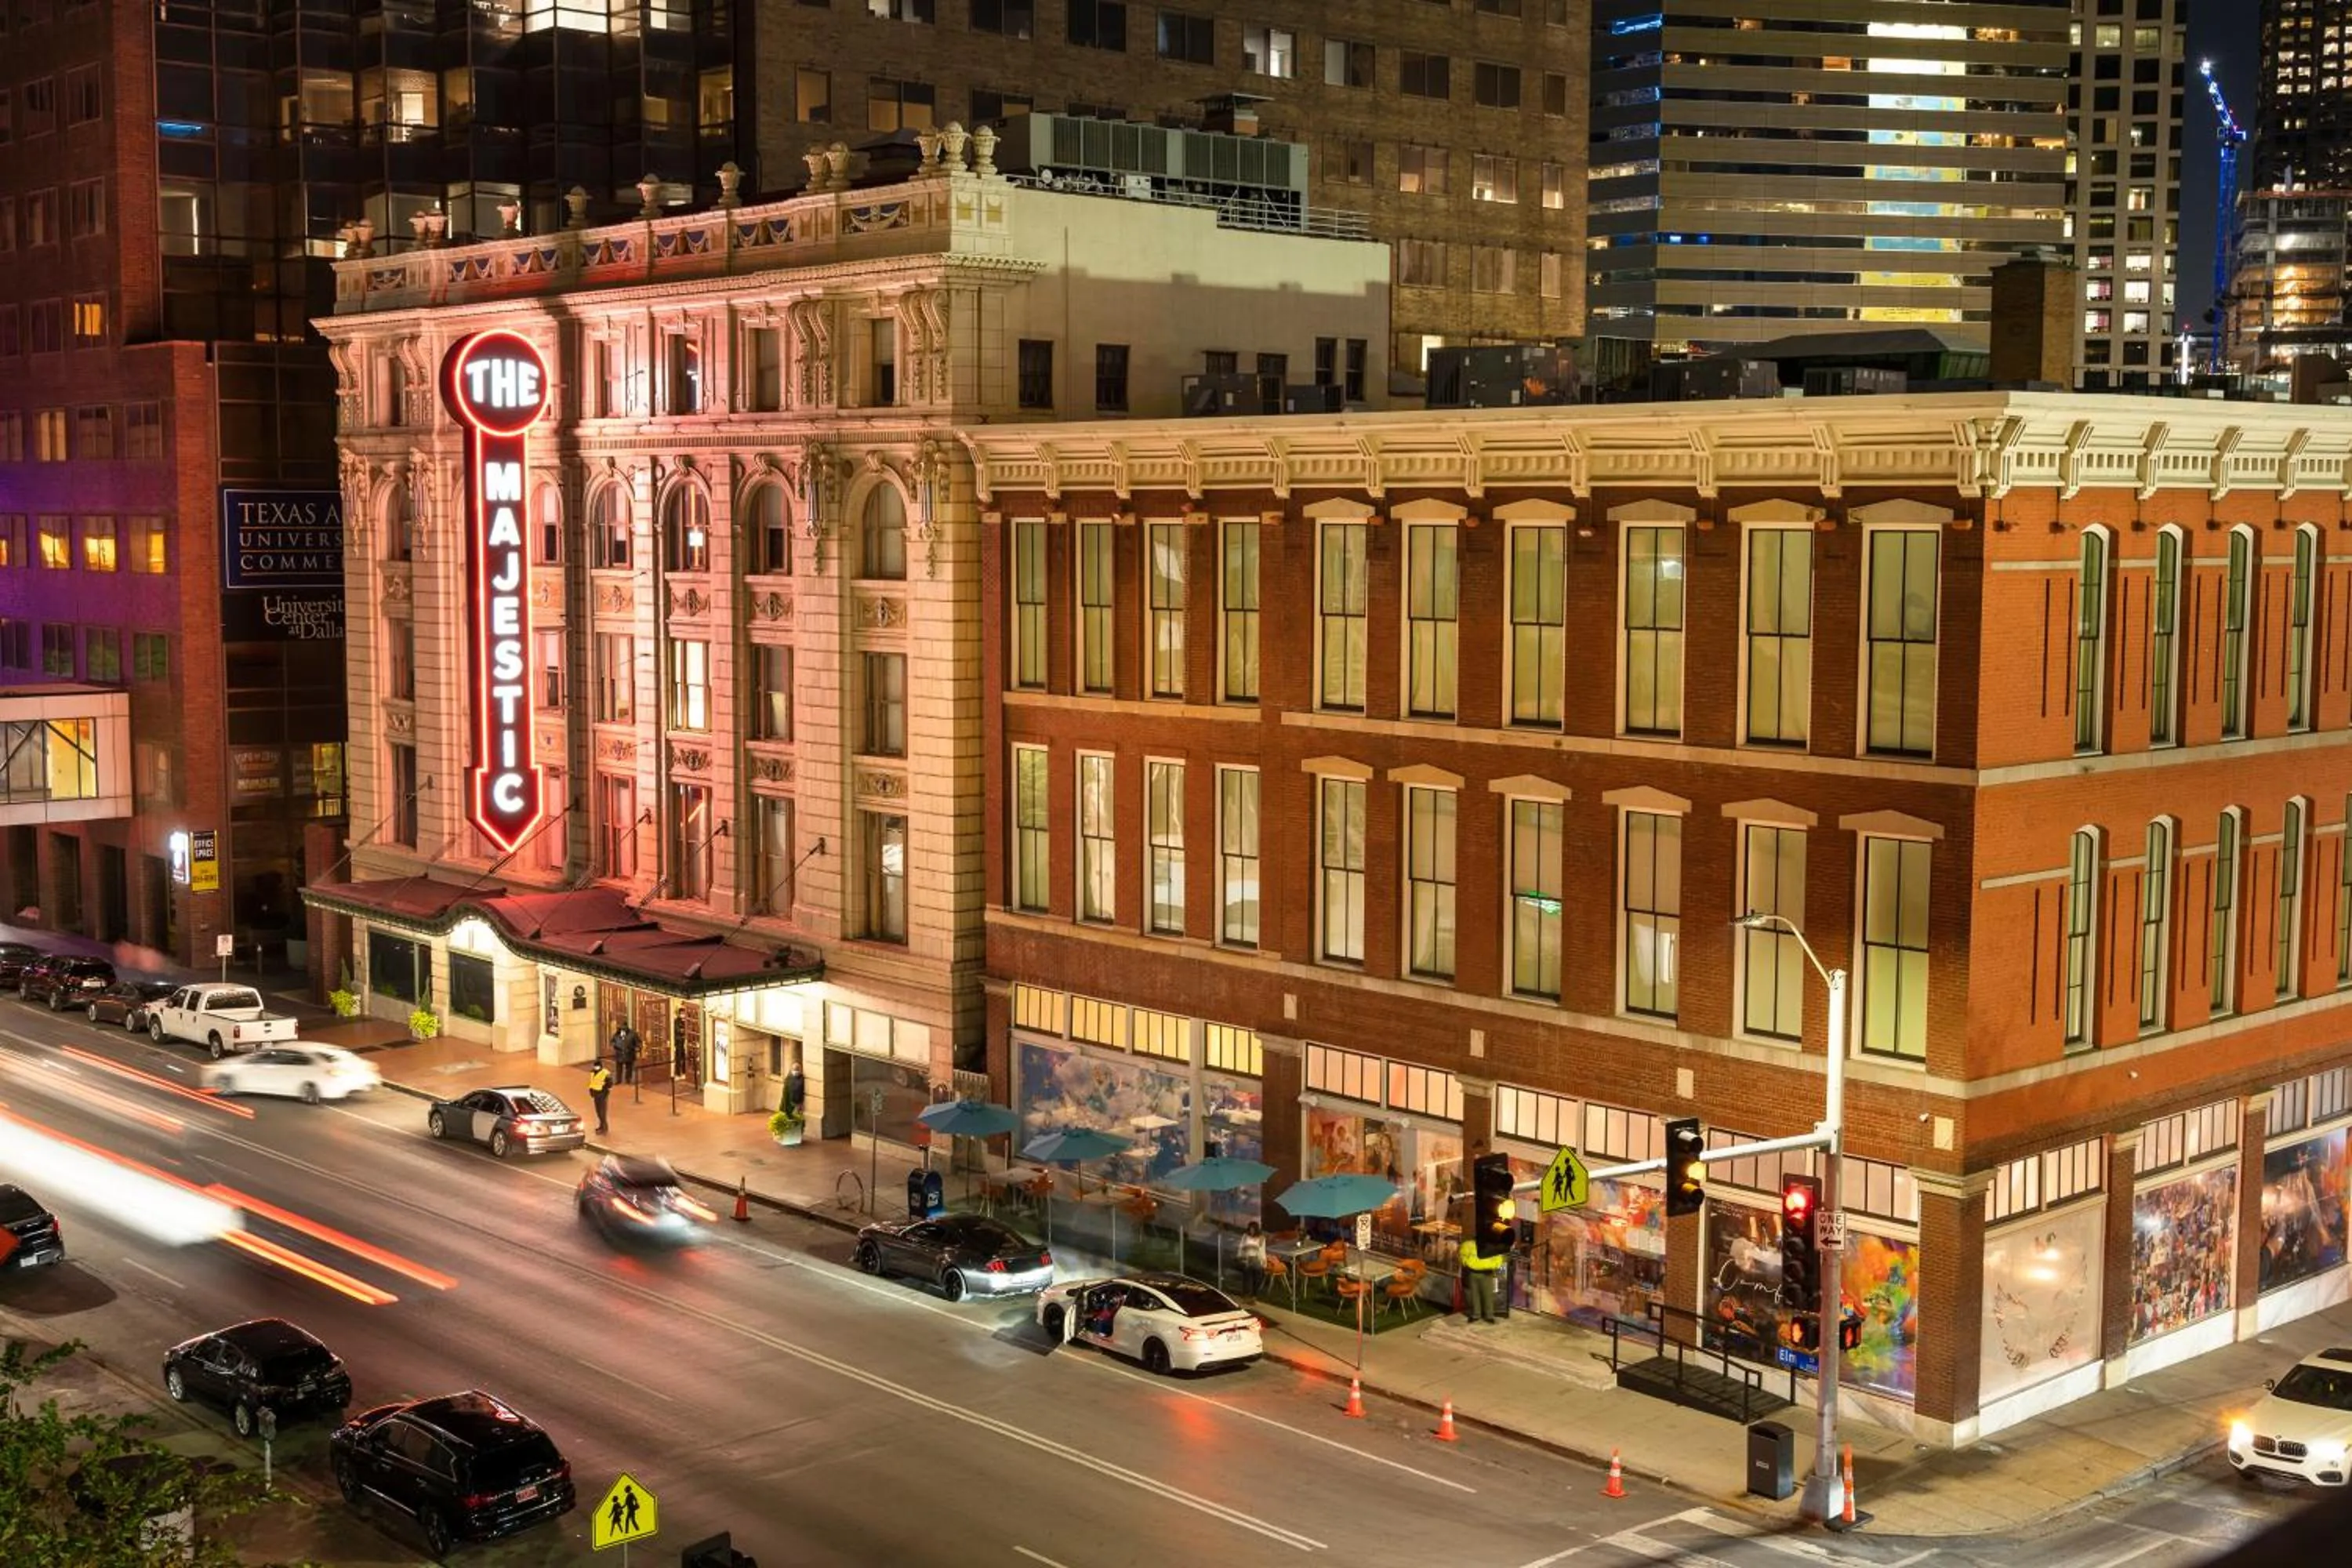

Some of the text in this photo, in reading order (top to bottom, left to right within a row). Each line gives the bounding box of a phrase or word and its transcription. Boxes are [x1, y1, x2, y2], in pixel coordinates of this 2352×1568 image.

[466, 359, 540, 408] THE
[238, 503, 316, 524] TEXAS
[239, 532, 343, 547] UNIVERS
[241, 555, 334, 570] COMME
[265, 609, 328, 625] Center
[485, 462, 524, 812] MAJESTIC
[1820, 1213, 1842, 1224] ONE
[1820, 1225, 1842, 1236] WAY
[1779, 1349, 1798, 1364] Elm
